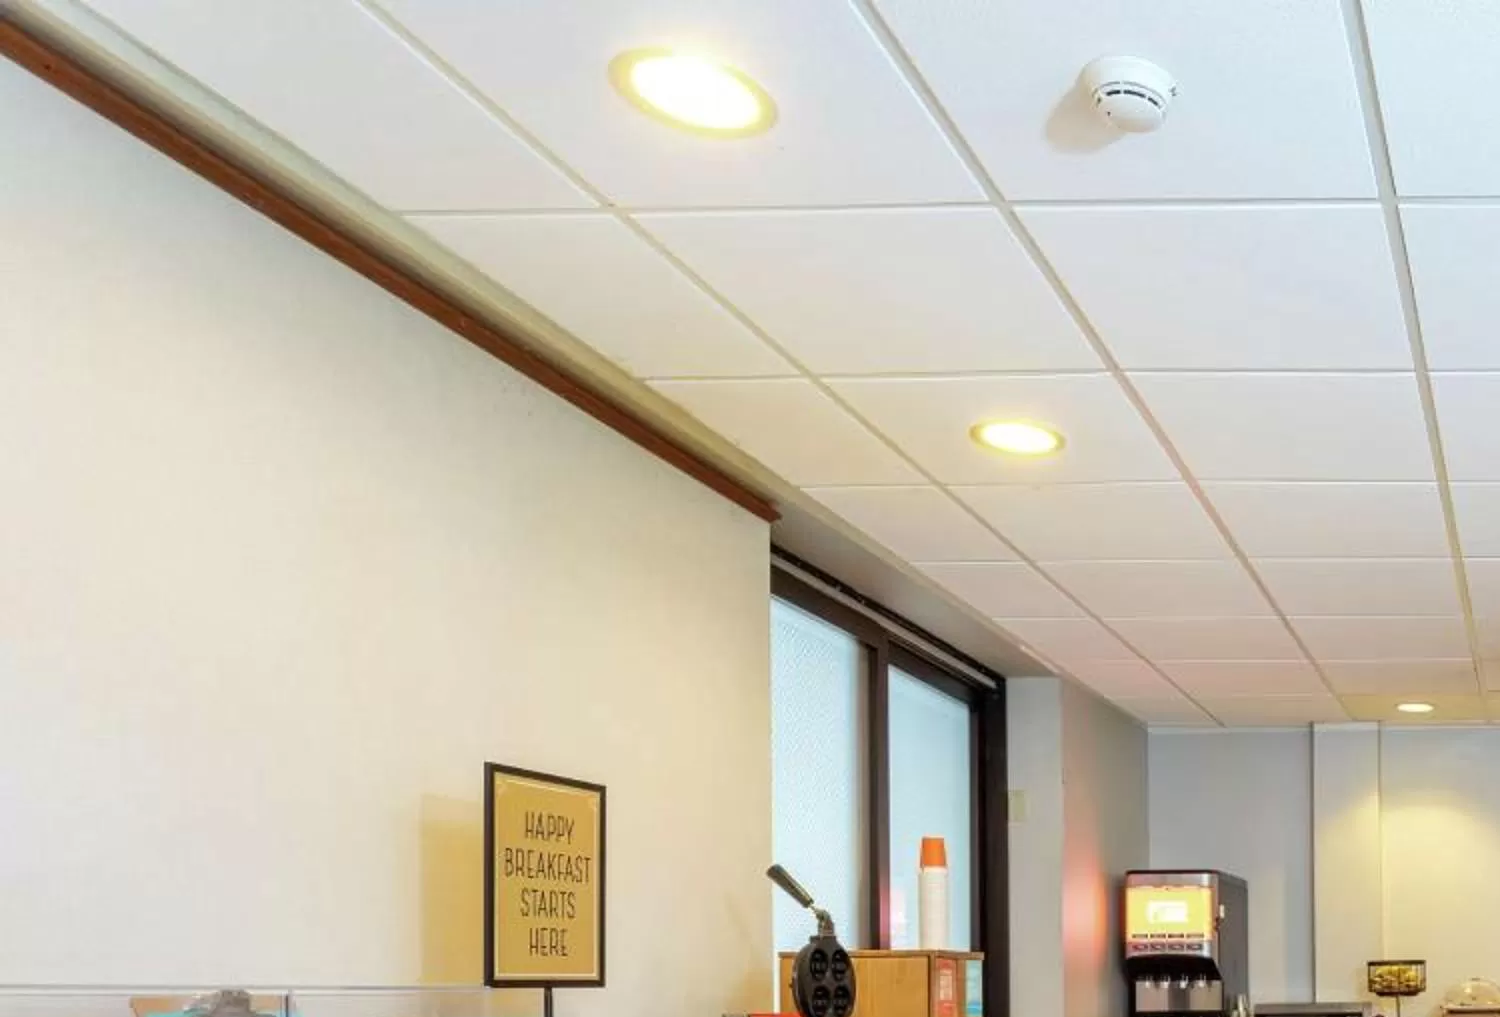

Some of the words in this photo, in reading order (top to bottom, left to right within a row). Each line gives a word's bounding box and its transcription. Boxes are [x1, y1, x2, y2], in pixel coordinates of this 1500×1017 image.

[524, 811, 575, 844] HAPPY
[504, 847, 592, 883] BREAKFAST
[519, 887, 576, 919] STARTS
[528, 927, 569, 957] HERE
